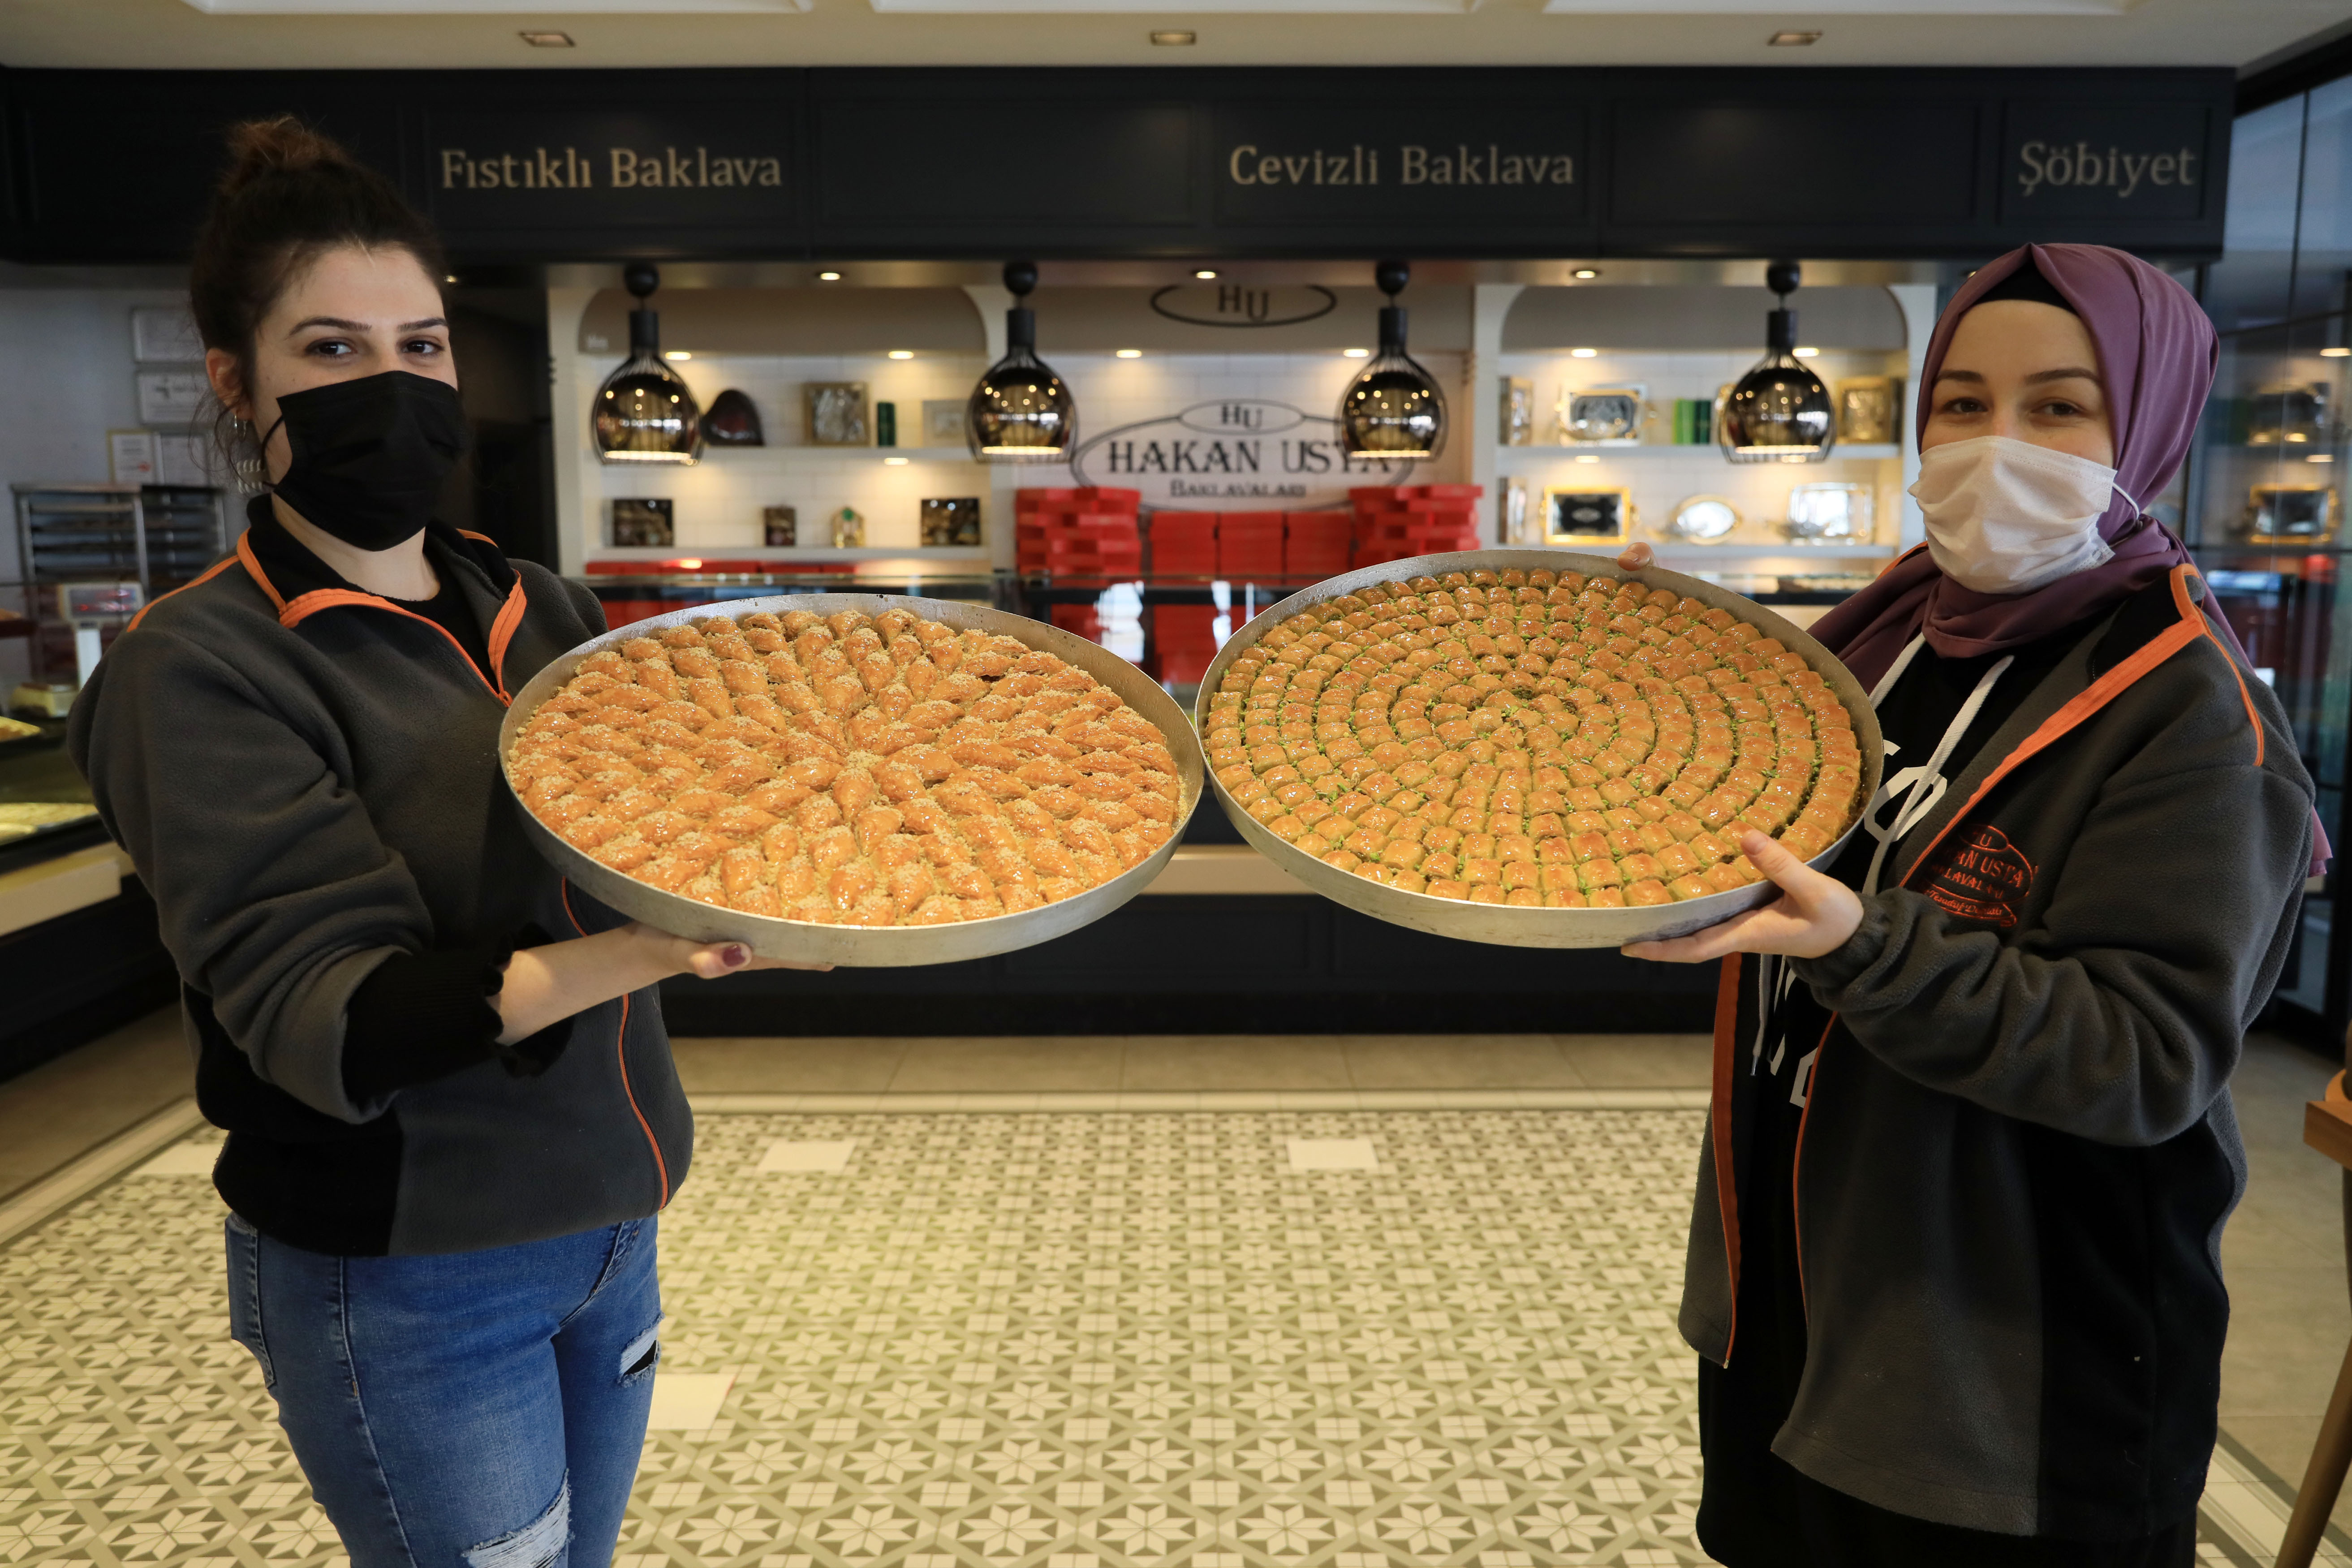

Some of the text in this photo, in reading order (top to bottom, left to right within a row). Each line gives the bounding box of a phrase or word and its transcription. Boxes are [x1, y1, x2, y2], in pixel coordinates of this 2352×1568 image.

[441, 147, 782, 188] Fıstıklı Baklava
[1229, 145, 1575, 185] Cevizli Baklava
[2018, 140, 2196, 198] Şöbiyet
[1218, 285, 1270, 322] HU
[1221, 403, 1263, 430] HU
[1107, 440, 1260, 474] HAKAN
[1980, 856, 2024, 888] USTA
